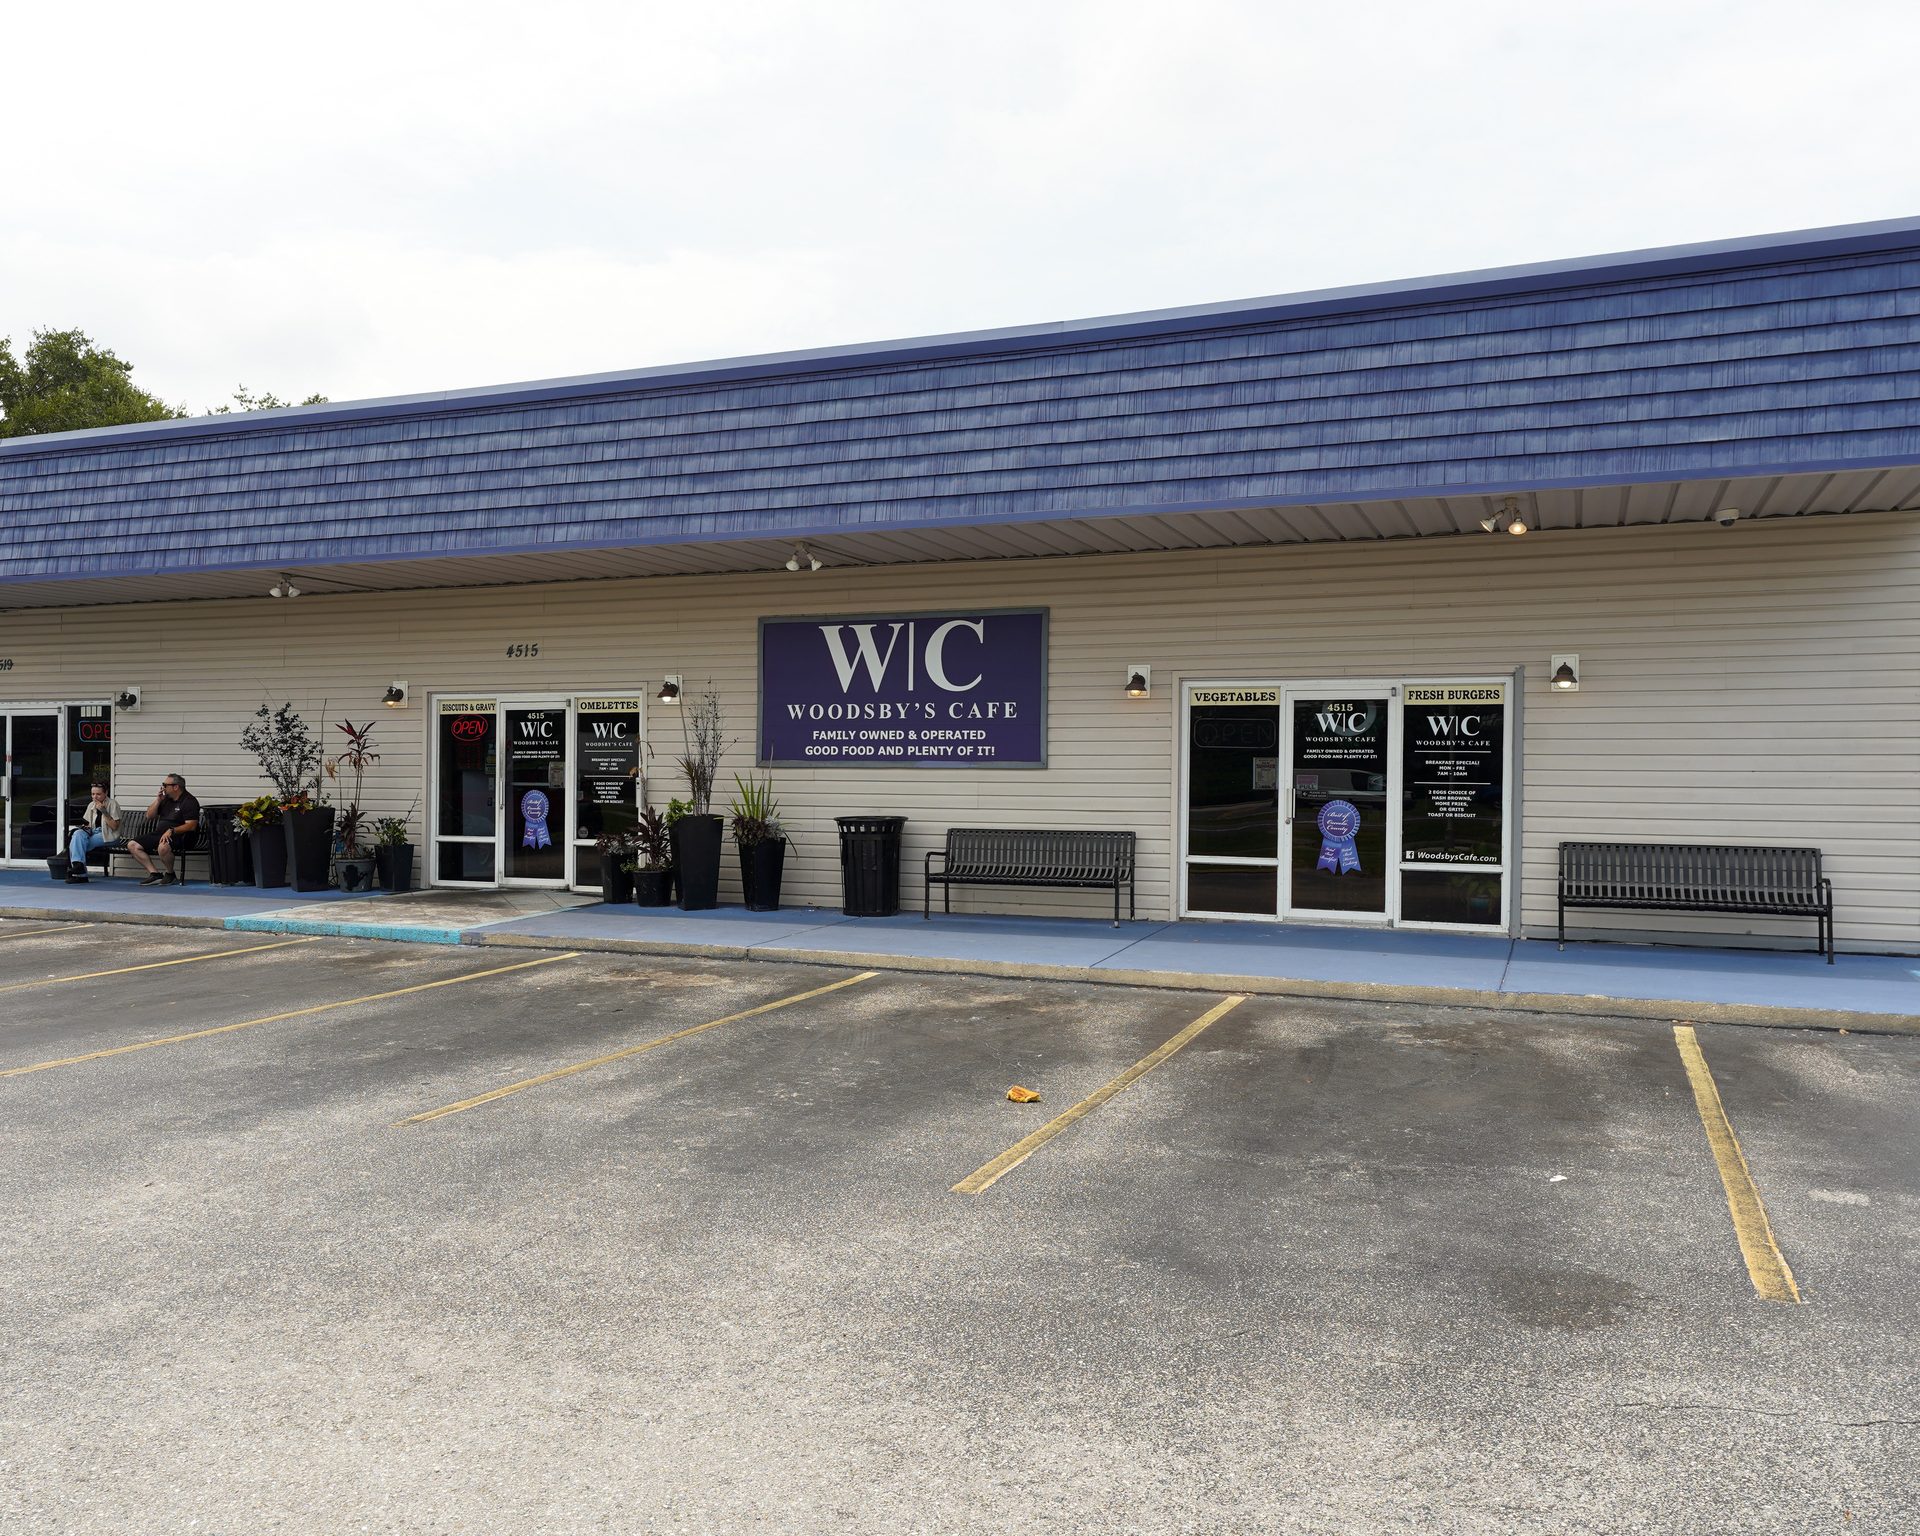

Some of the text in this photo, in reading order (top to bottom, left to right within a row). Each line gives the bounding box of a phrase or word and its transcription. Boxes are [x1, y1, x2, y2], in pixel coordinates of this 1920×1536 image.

[506, 643, 539, 657] 4515
[1195, 692, 1276, 701] VEGETABLES
[1408, 690, 1500, 700] FRESH BURGERS
[580, 701, 638, 709] OMELETTES
[1327, 704, 1353, 712] 4515
[787, 702, 1017, 720] WOODSBY'S CAFE
[453, 721, 484, 734] OPEN
[813, 730, 986, 740] FAMILY OWNED & OPERATED
[805, 746, 995, 756] GOOD FOOD AND PLENTY OF IT!
[1417, 852, 1497, 862] WoodsbysCafe.com
